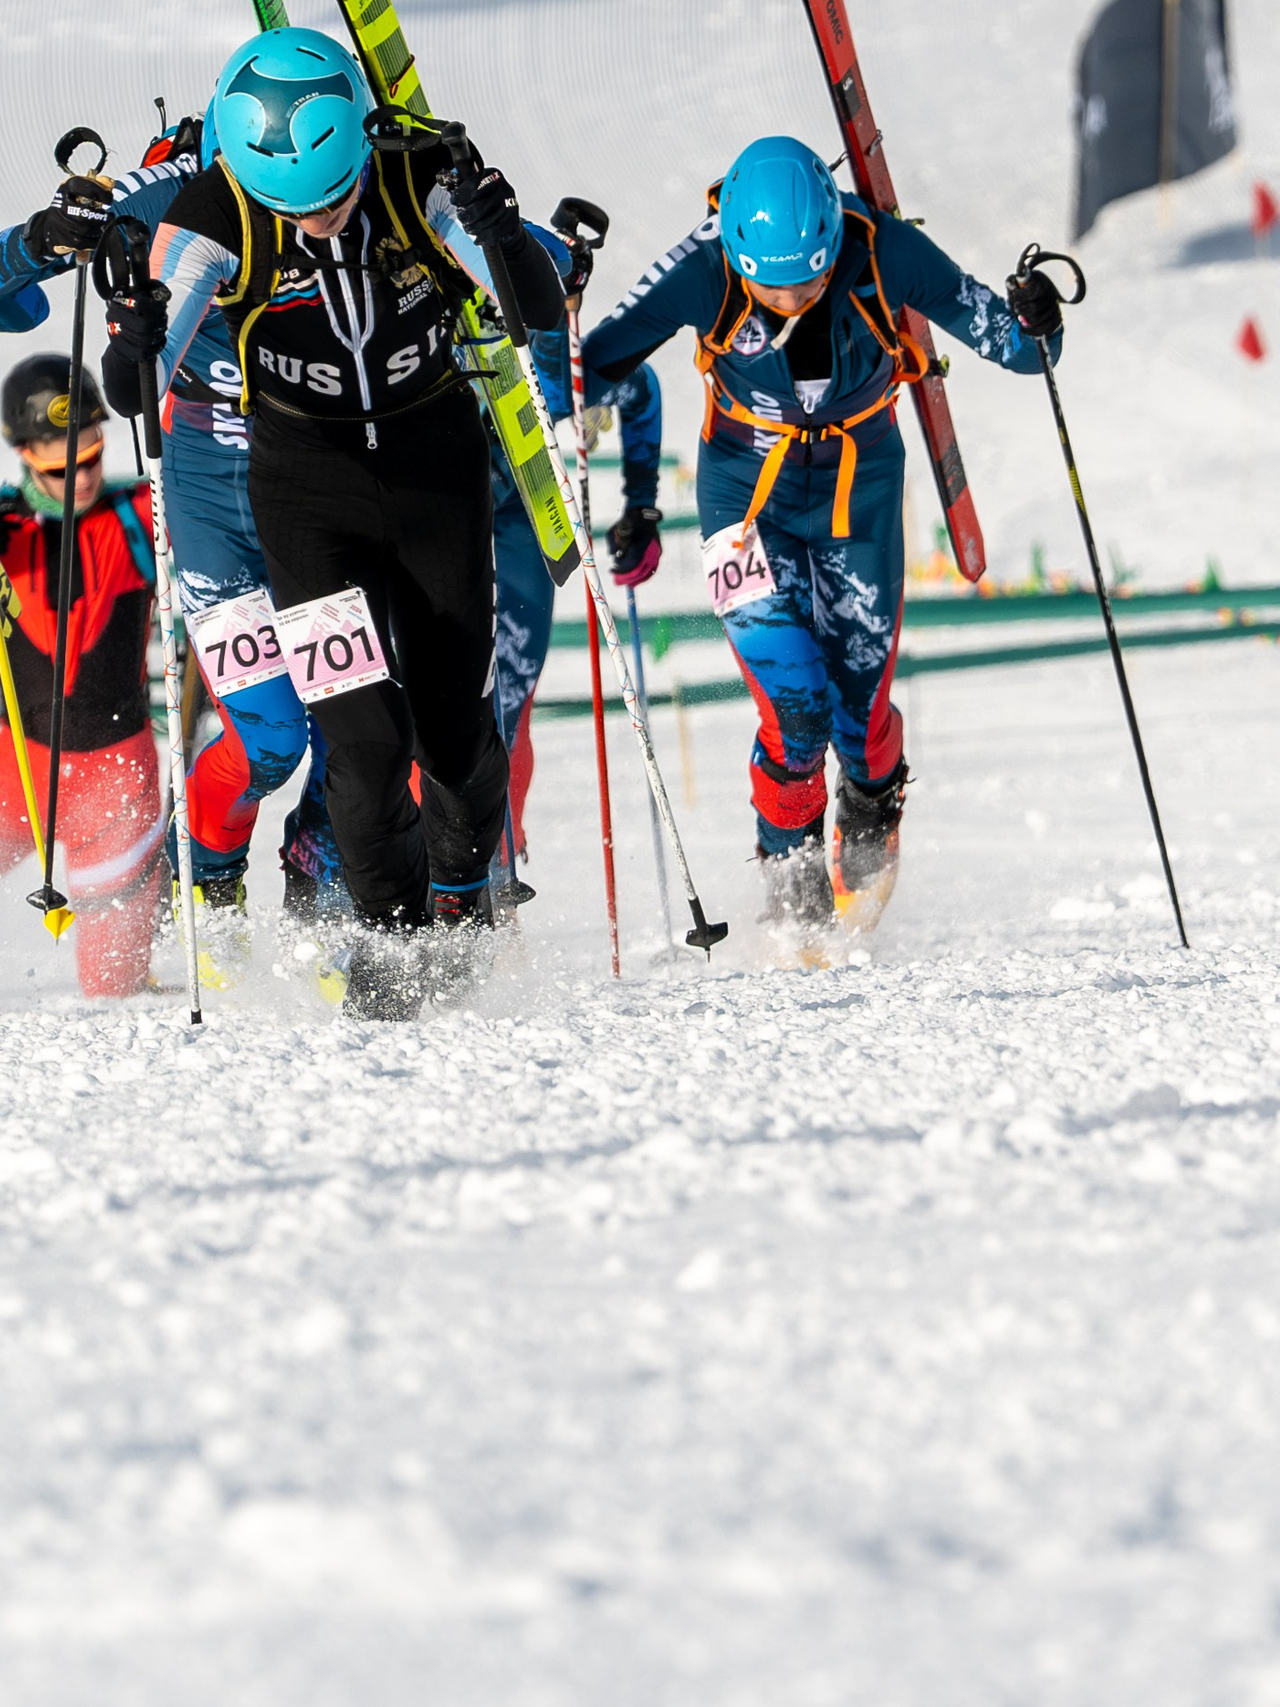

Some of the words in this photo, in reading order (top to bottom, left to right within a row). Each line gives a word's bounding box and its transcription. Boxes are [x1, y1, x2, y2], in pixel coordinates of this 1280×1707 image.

[770, 252, 804, 263] CAMP
[708, 551, 766, 600] 704
[205, 625, 282, 678] 703
[294, 626, 375, 683] 701
